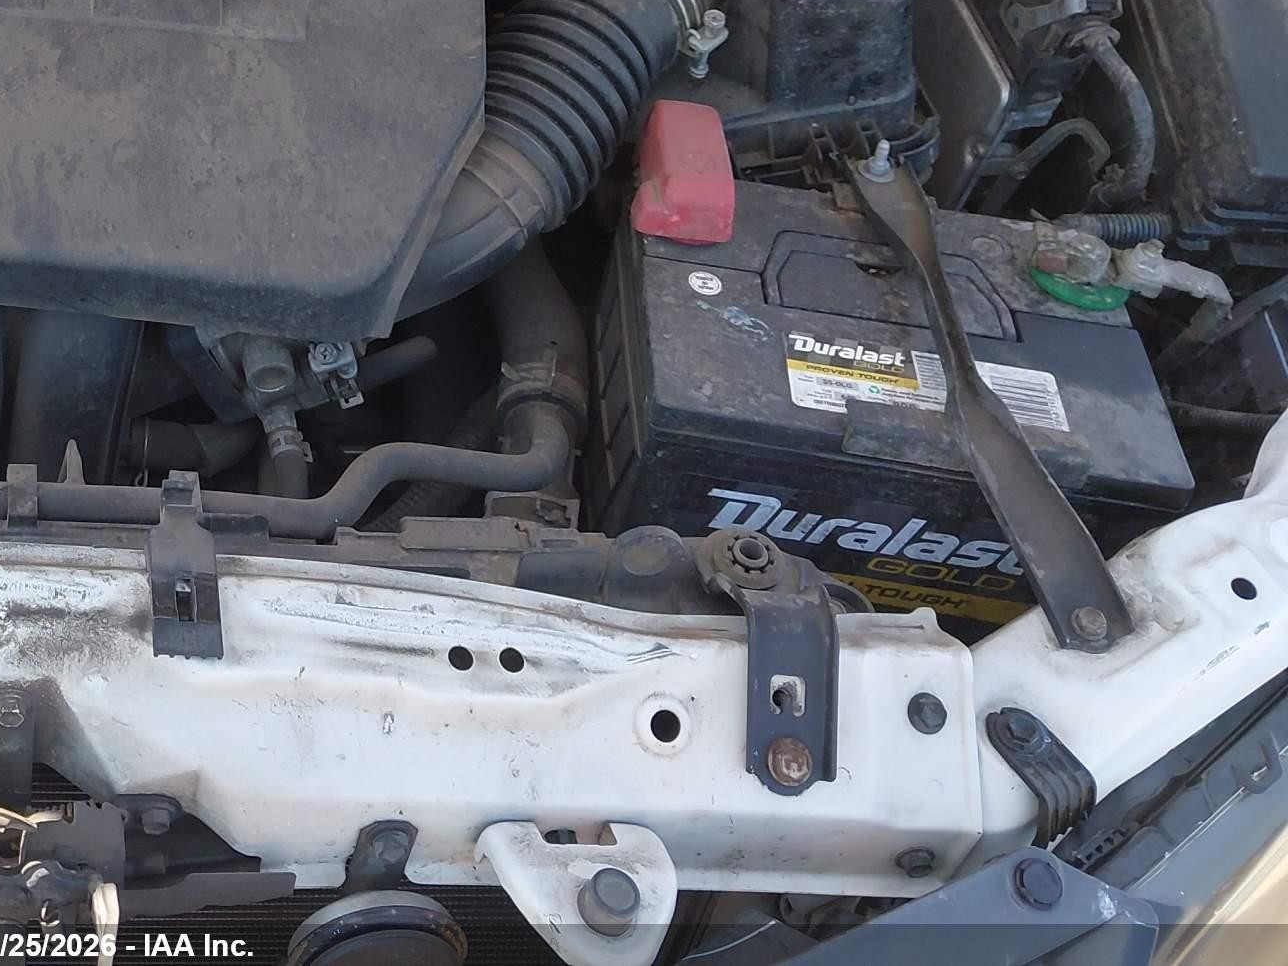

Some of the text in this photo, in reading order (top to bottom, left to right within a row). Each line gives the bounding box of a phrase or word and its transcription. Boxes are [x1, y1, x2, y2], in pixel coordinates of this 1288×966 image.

[788, 333, 906, 367] Duralast
[806, 364, 900, 385] PROVEN TOUGH
[853, 360, 905, 374] GOLD
[866, 557, 1015, 591] GOLD
[865, 583, 967, 609] TOUGH
